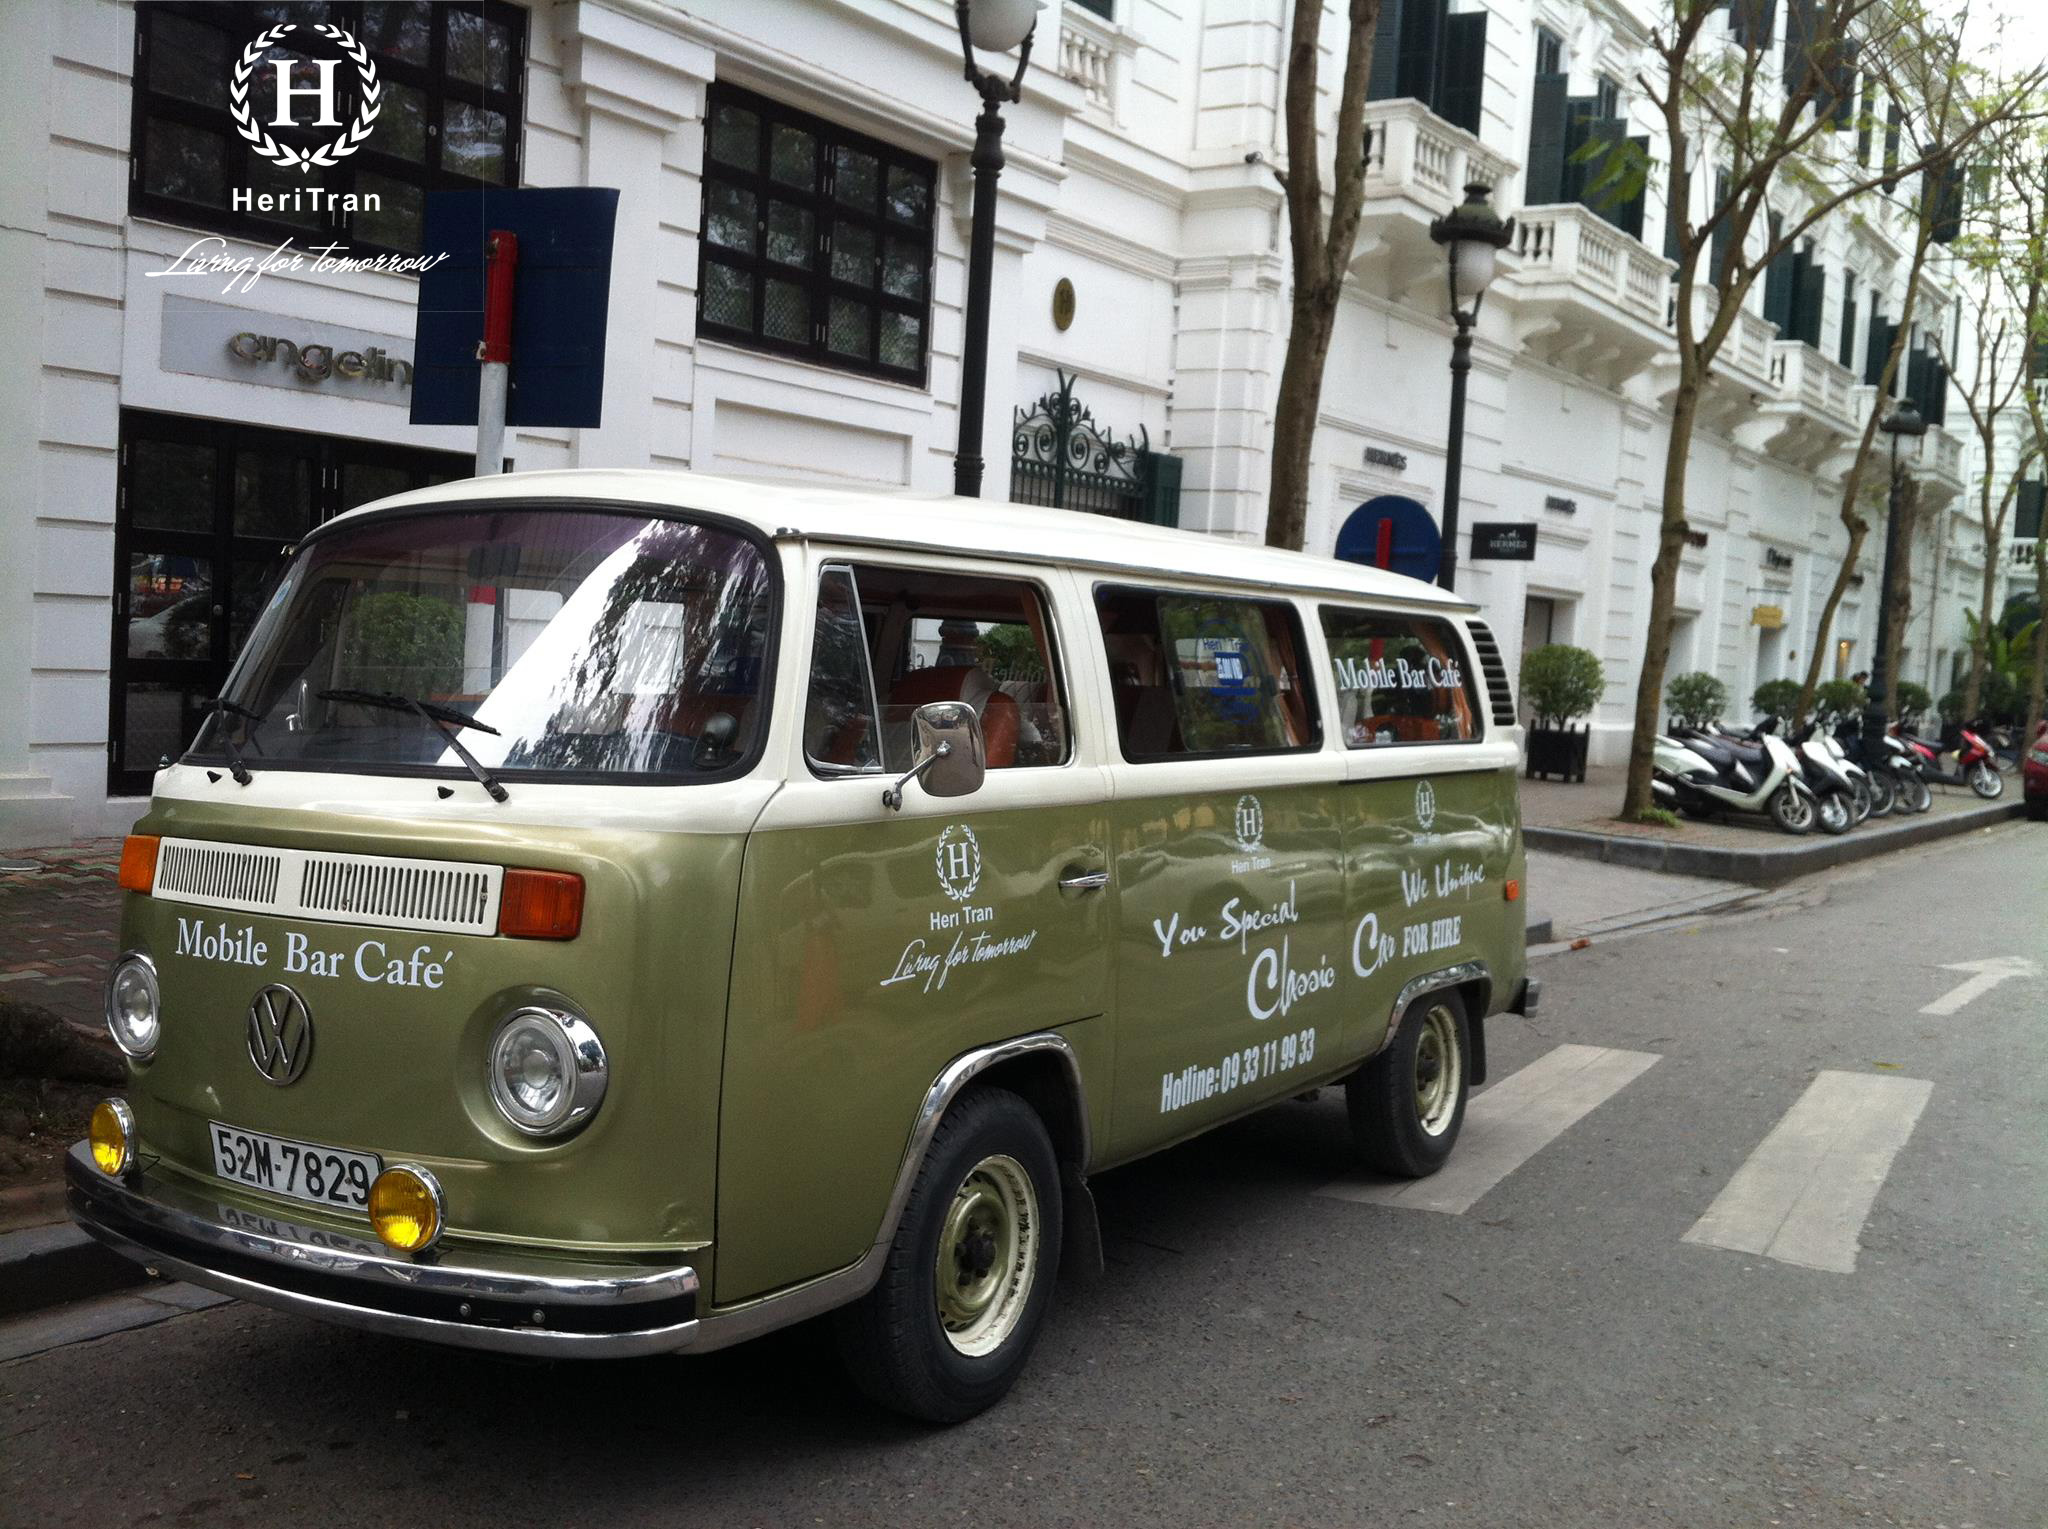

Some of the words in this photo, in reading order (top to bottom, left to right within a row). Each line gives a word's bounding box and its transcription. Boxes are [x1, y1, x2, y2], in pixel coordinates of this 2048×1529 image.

[227, 331, 413, 386] angelin
[1334, 657, 1397, 690] Mobile
[1396, 658, 1427, 689] Bar
[1241, 808, 1257, 836] H
[947, 842, 971, 880] H
[930, 912, 959, 931] Heri
[962, 906, 993, 925] Tran
[1153, 912, 1207, 957] You
[1220, 879, 1298, 955] Special
[1401, 868, 1429, 908] We
[175, 917, 268, 967] Mobile
[283, 931, 345, 978] Bar
[880, 938, 941, 995] Living
[936, 931, 969, 991] for
[1248, 934, 1336, 1020] Classic
[1402, 923, 1428, 958] FOR
[1430, 915, 1461, 951] HIRE
[1241, 1045, 1260, 1085] 33
[1262, 1039, 1278, 1077] 11
[1280, 1033, 1298, 1072] 99
[1298, 1027, 1316, 1065] 33
[217, 1129, 371, 1206] 52M-7829
